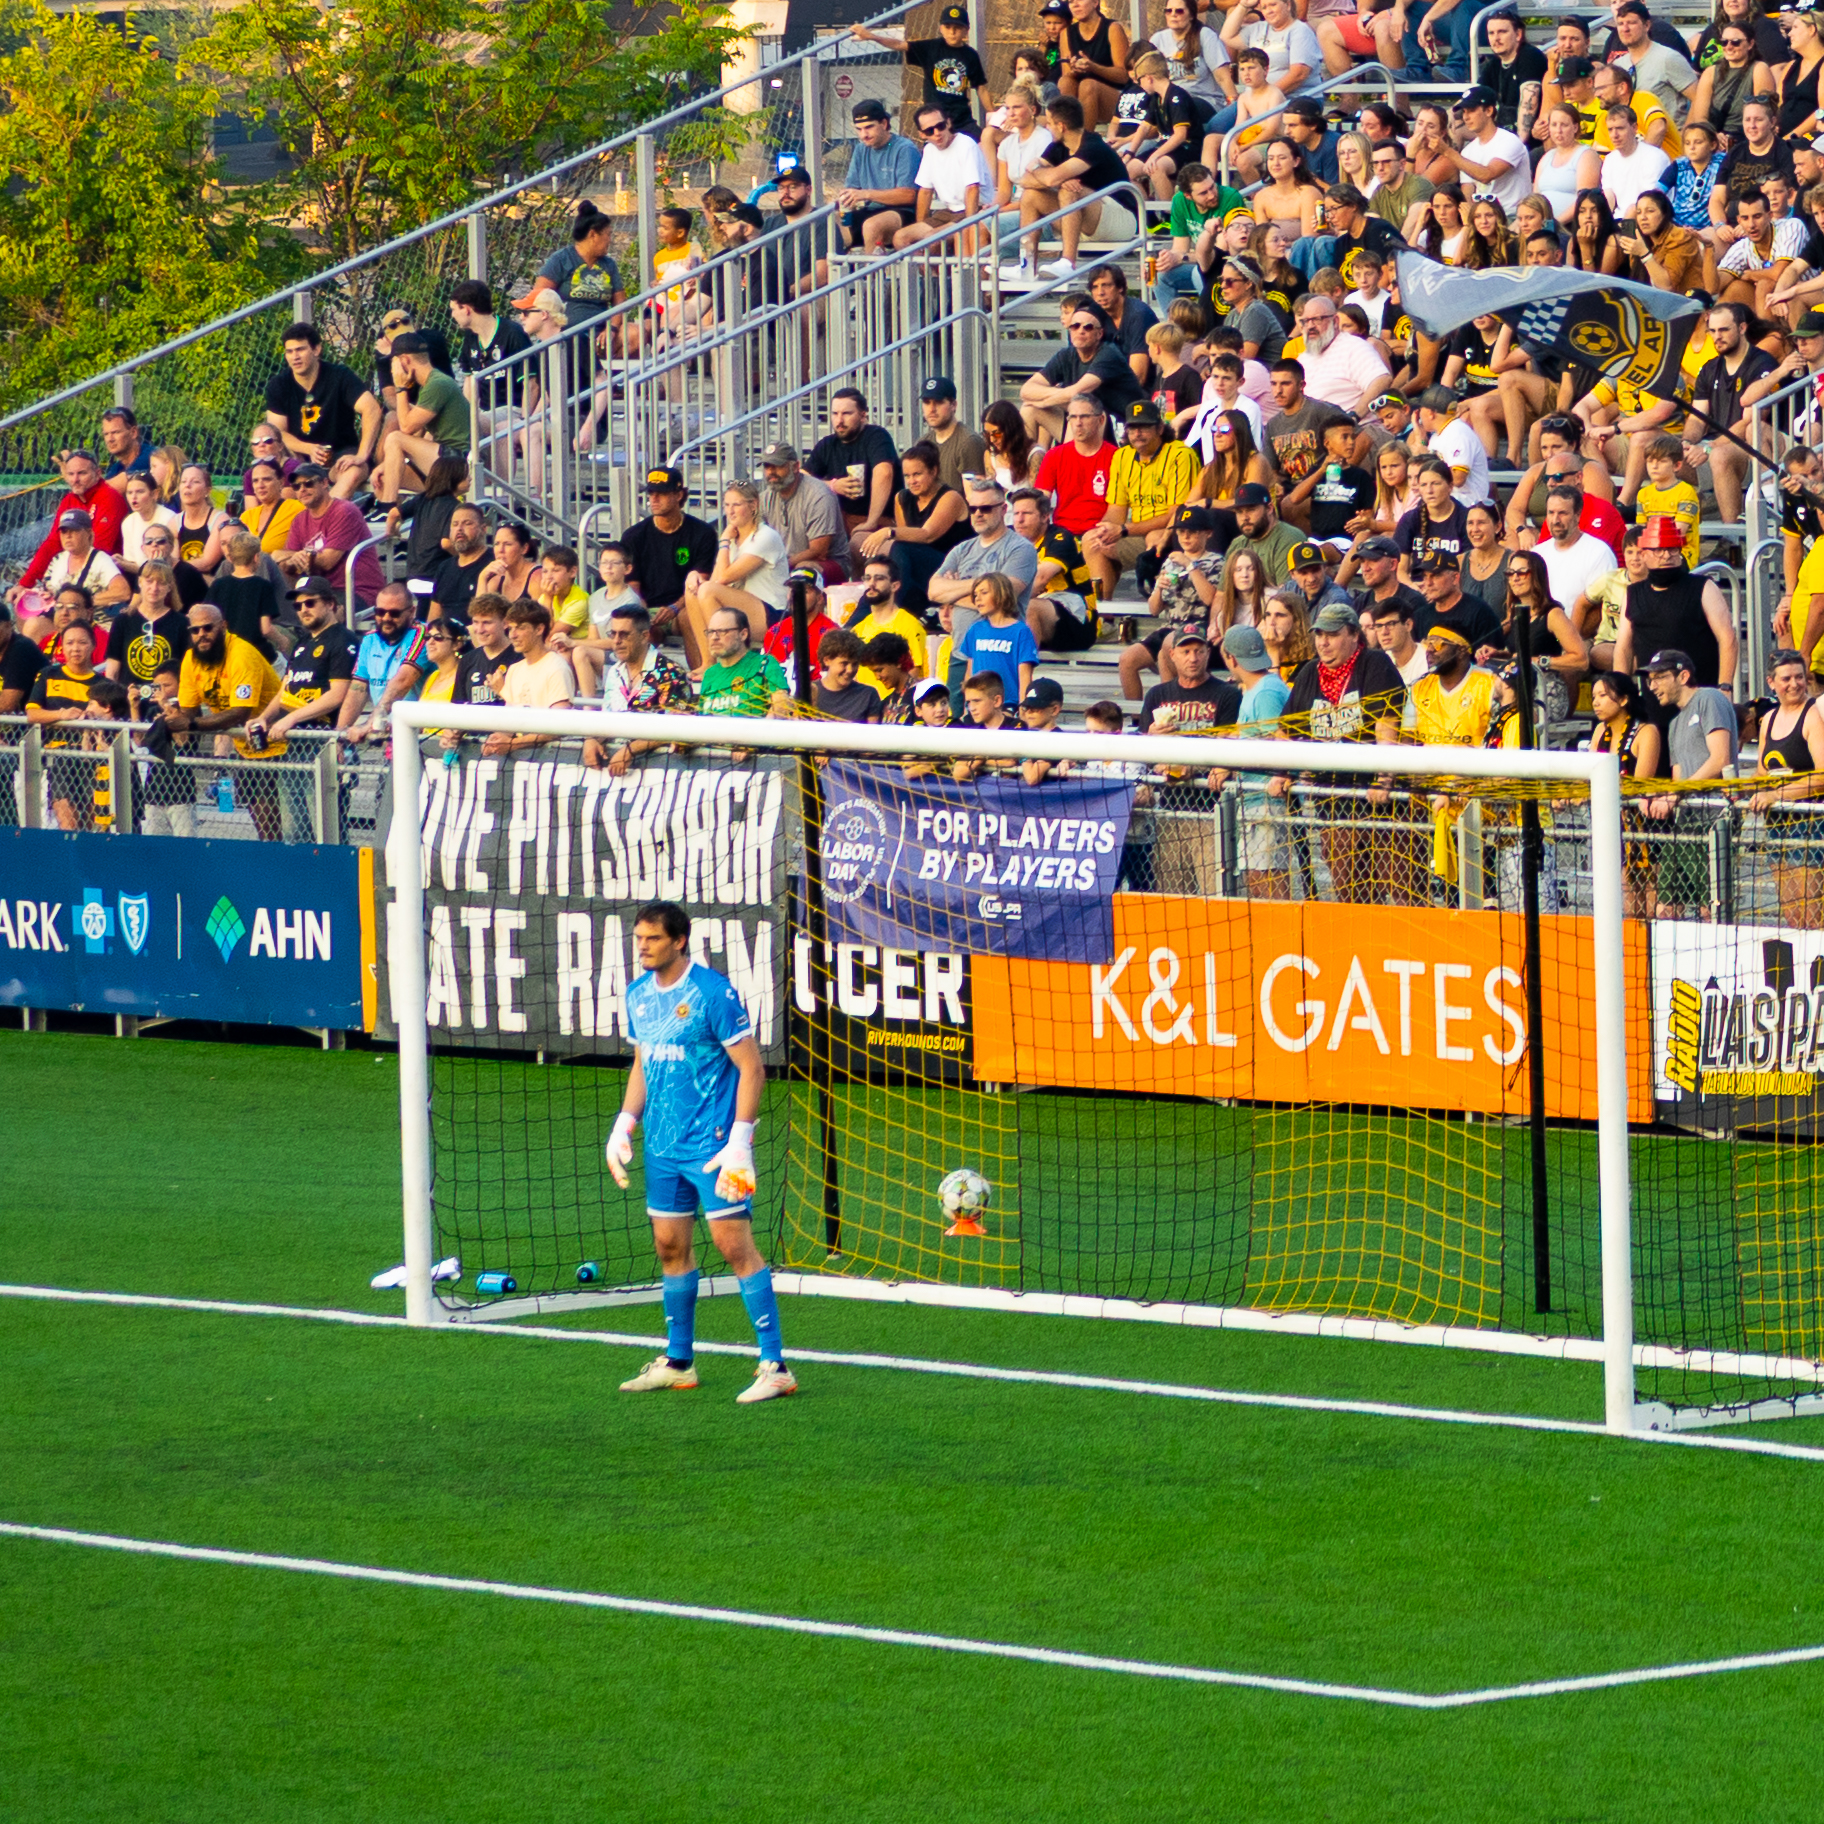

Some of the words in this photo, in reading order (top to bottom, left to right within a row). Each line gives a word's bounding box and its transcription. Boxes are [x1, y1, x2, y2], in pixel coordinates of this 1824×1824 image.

[1133, 405, 1142, 416] P
[1134, 494, 1165, 506] FRIEND
[1181, 511, 1191, 521] P
[508, 760, 783, 906] PITTSBURGH
[917, 808, 970, 846] FOR
[978, 813, 1117, 854] PLAYERS
[823, 841, 875, 863] LABOR
[828, 862, 860, 881] DAY
[918, 848, 957, 882] BY
[965, 851, 1098, 891] PLAYERS
[249, 907, 331, 961] AHN
[1091, 946, 1237, 1048] K&L
[1260, 953, 1526, 1065] GATES
[867, 1030, 965, 1052] RIVERHOUNDS.COM
[1664, 977, 1702, 1093] RADIO
[1700, 987, 1779, 1073] LAS
[653, 1044, 685, 1062] AHN
